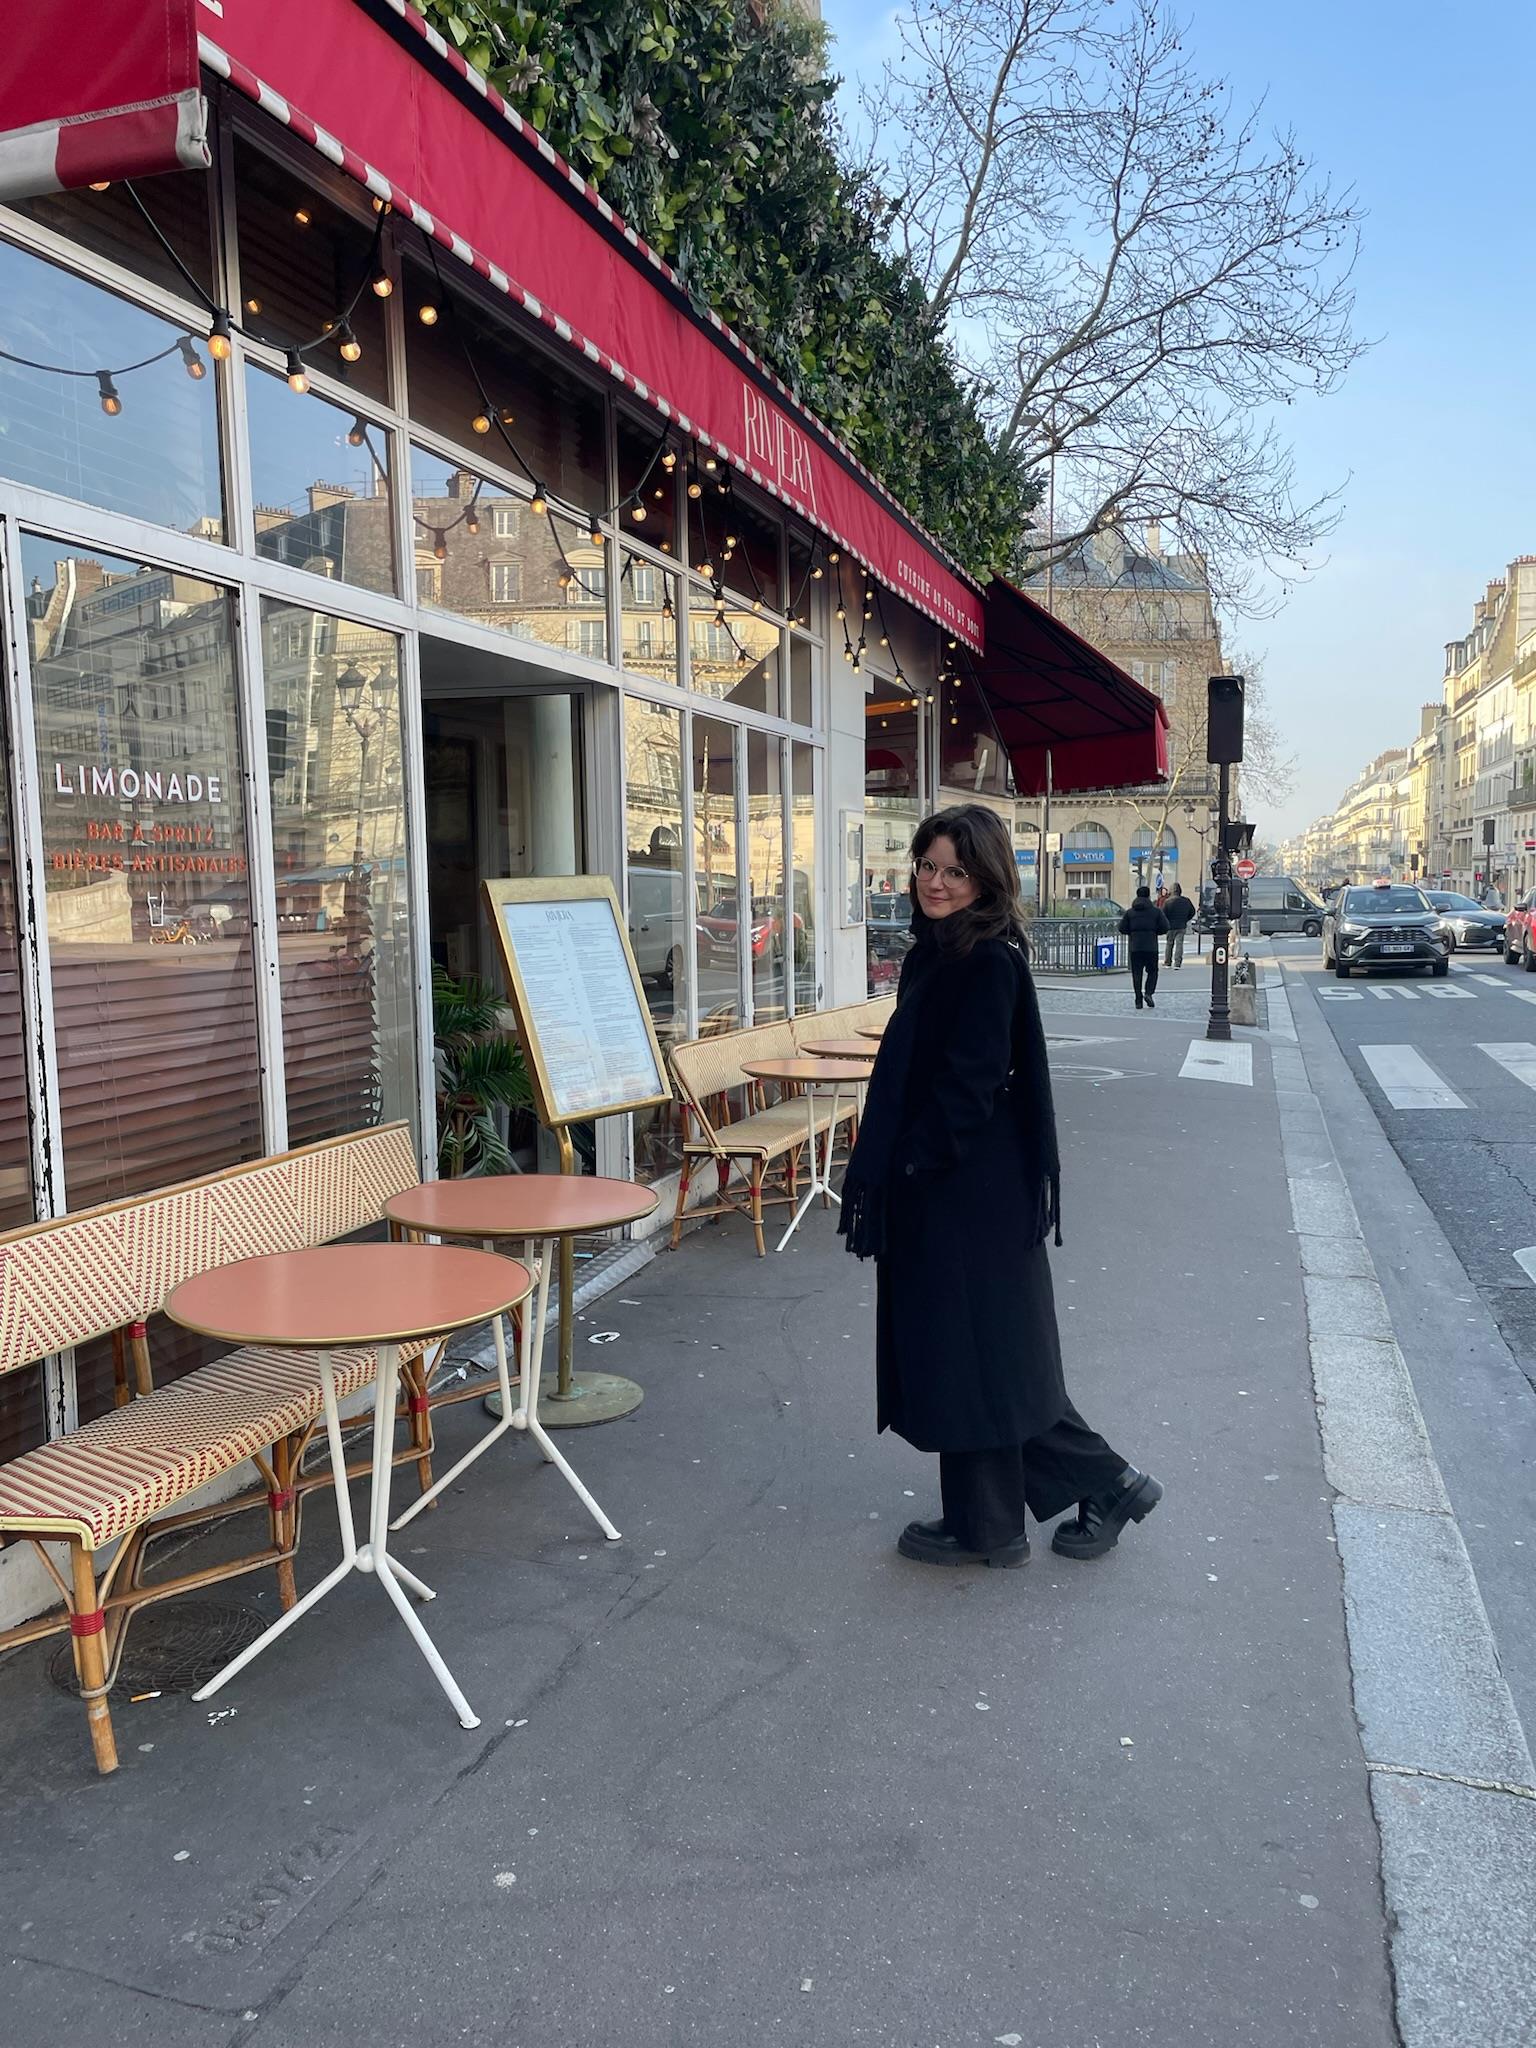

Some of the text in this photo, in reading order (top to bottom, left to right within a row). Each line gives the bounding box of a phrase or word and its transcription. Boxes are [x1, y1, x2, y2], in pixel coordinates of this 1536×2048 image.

[742, 382, 818, 515] RIVIERA
[897, 559, 931, 599] CUISINE
[933, 588, 942, 608] AU
[943, 597, 955, 620] FEU
[55, 762, 222, 803] LIMONADE
[87, 820, 125, 841] BAR
[151, 822, 215, 845] SPRITZ
[52, 847, 247, 873] BIÈRES ARTISANALES
[1101, 947, 1110, 965] P
[1317, 984, 1478, 1001] BUS
